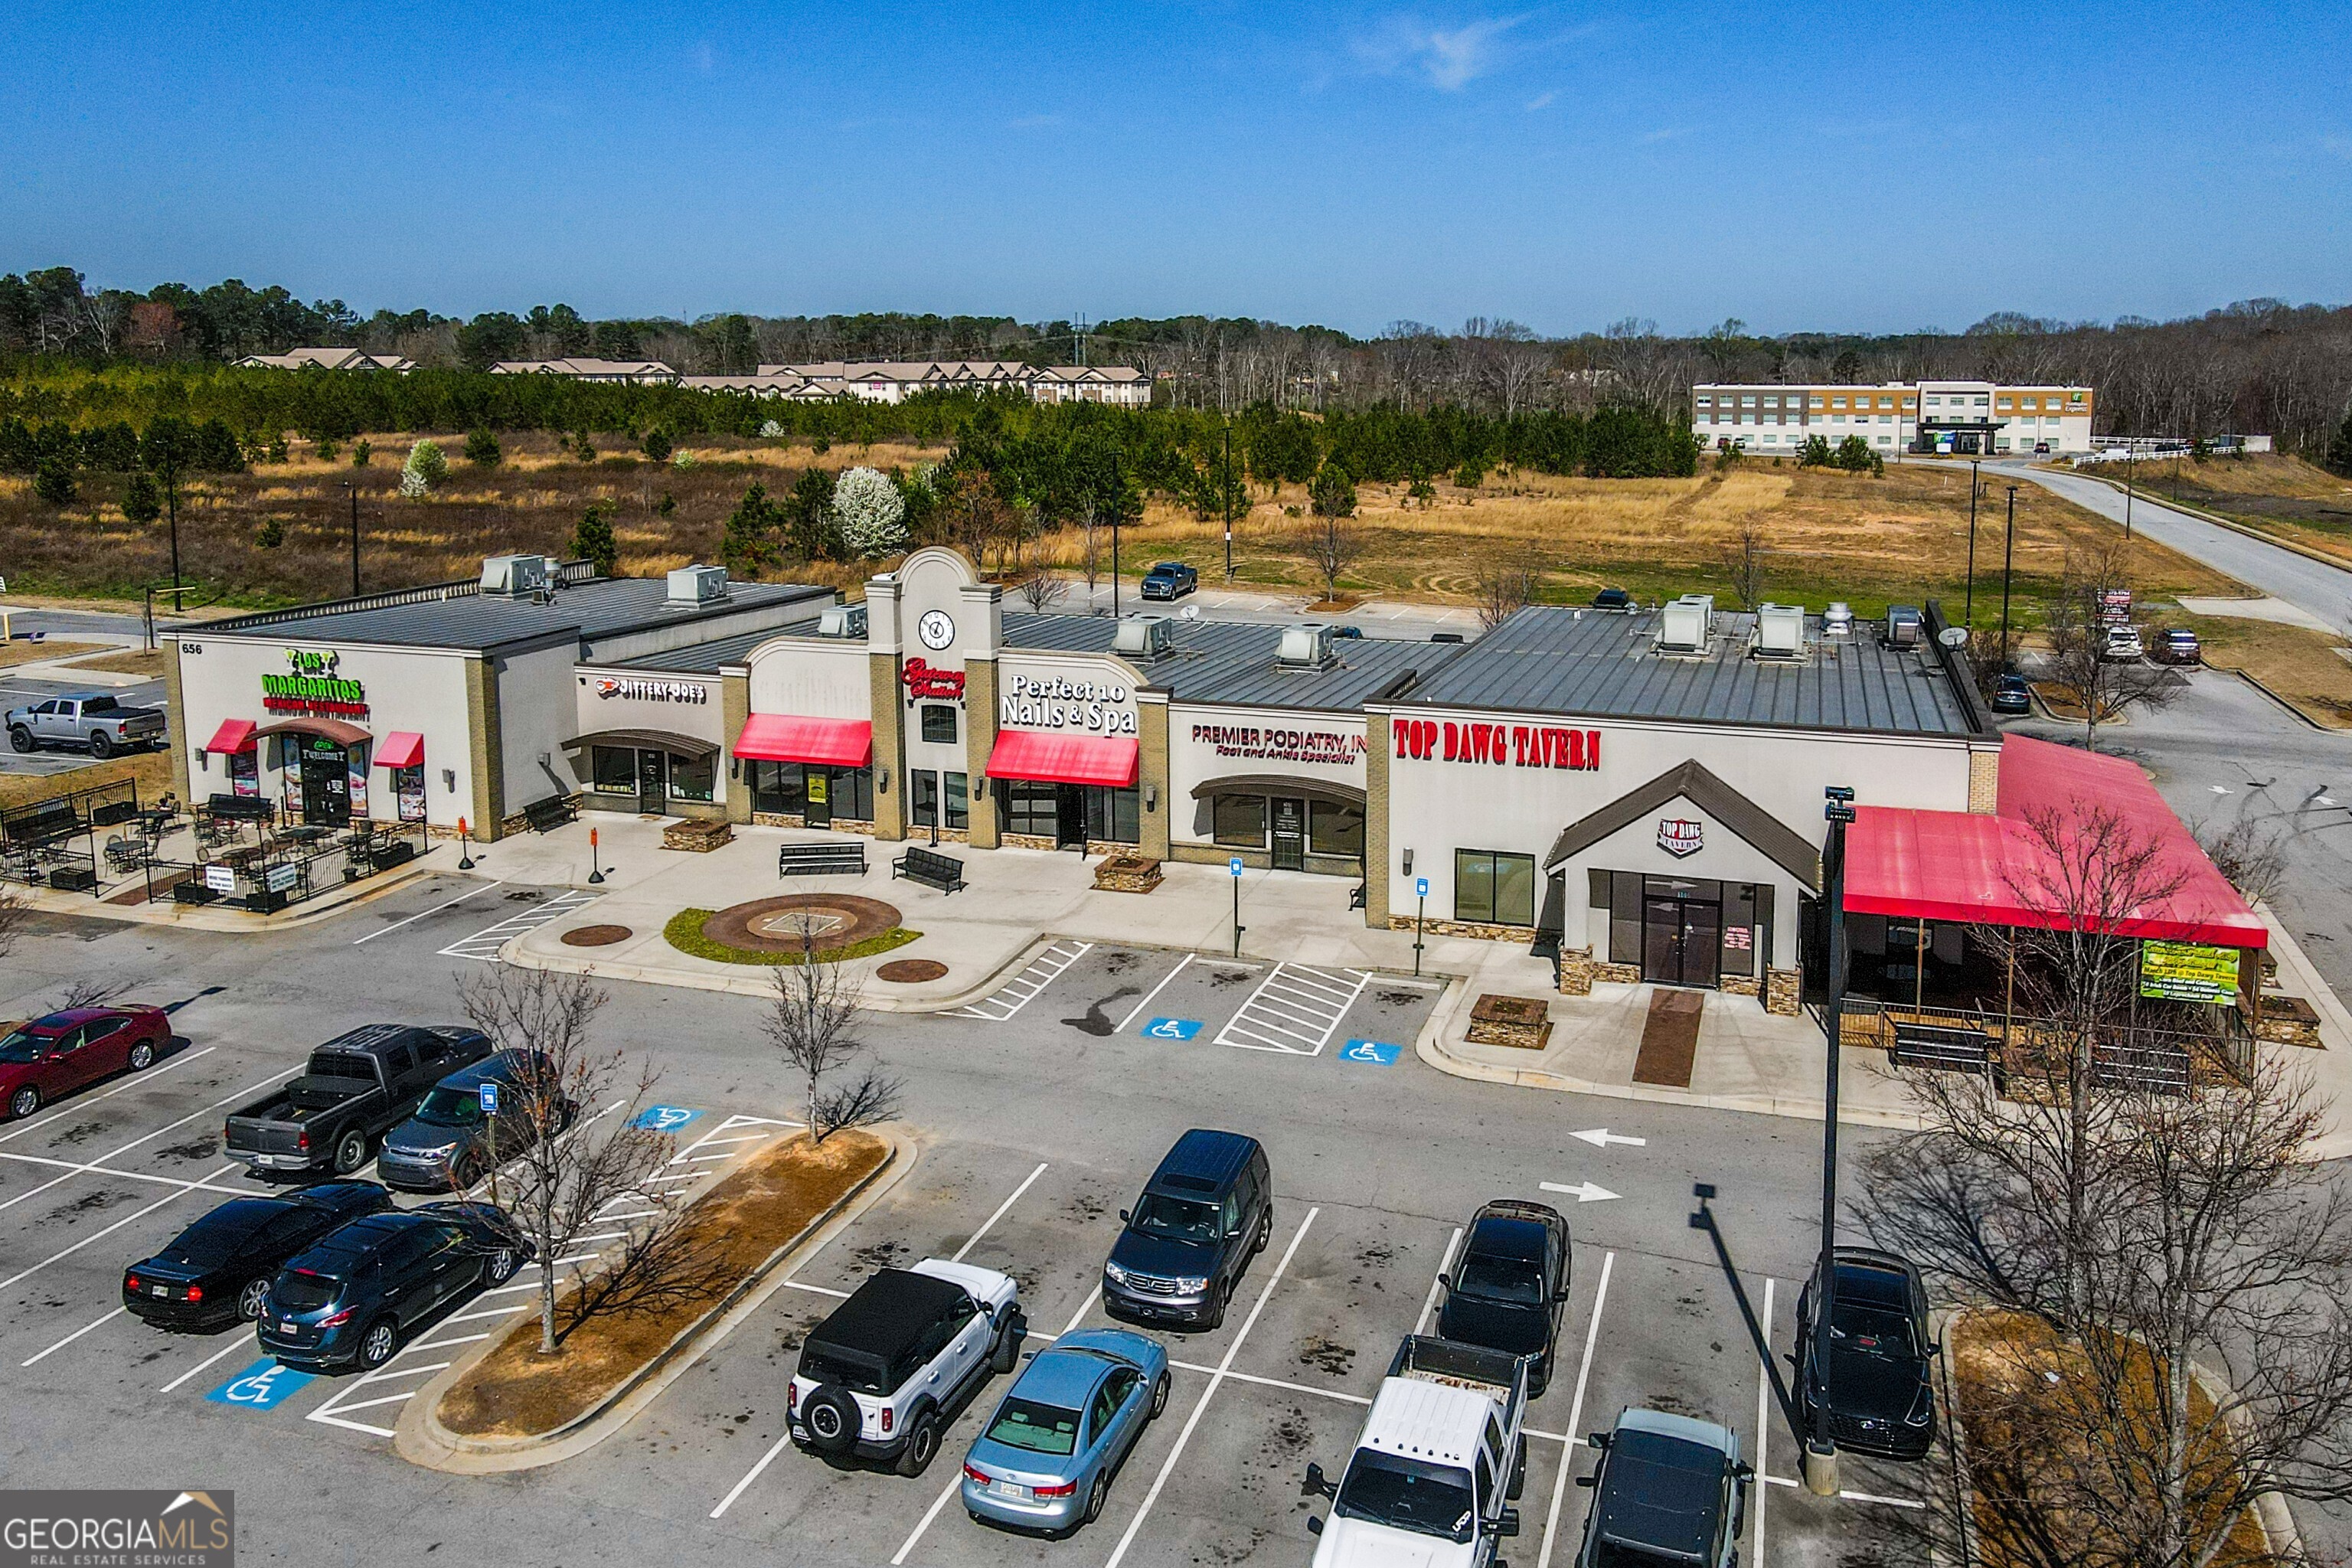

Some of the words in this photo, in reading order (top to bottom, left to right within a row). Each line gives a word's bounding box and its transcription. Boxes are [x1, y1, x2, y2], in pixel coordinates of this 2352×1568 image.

[182, 644, 202, 654] 656
[298, 652, 320, 668] LOS
[262, 675, 362, 699] MARGARITAS
[619, 680, 669, 696] JITTERY
[671, 683, 704, 698] JOE'S
[1011, 675, 1094, 702] Perfect
[1099, 684, 1125, 702] 10
[263, 697, 305, 710] MEXICAN
[308, 700, 368, 715] RESTAURANT
[1001, 695, 1064, 727] Nails
[1069, 704, 1083, 725] &
[1088, 702, 1136, 737] Spa
[1192, 724, 1260, 746] PREMIER
[1265, 729, 1348, 753] PODIATRY,
[1393, 720, 1438, 760] TOP
[1443, 723, 1507, 766] DAWG
[1513, 727, 1601, 771] TAVERN
[309, 750, 338, 761] WELCOME
[1216, 744, 1241, 756] Foot
[1243, 746, 1263, 758] and
[1266, 749, 1298, 761] Ankle
[1301, 750, 1355, 765] Specialist
[1662, 822, 1677, 838] TOP
[1679, 823, 1700, 838] DAWG
[1664, 838, 1697, 848] TAVERN
